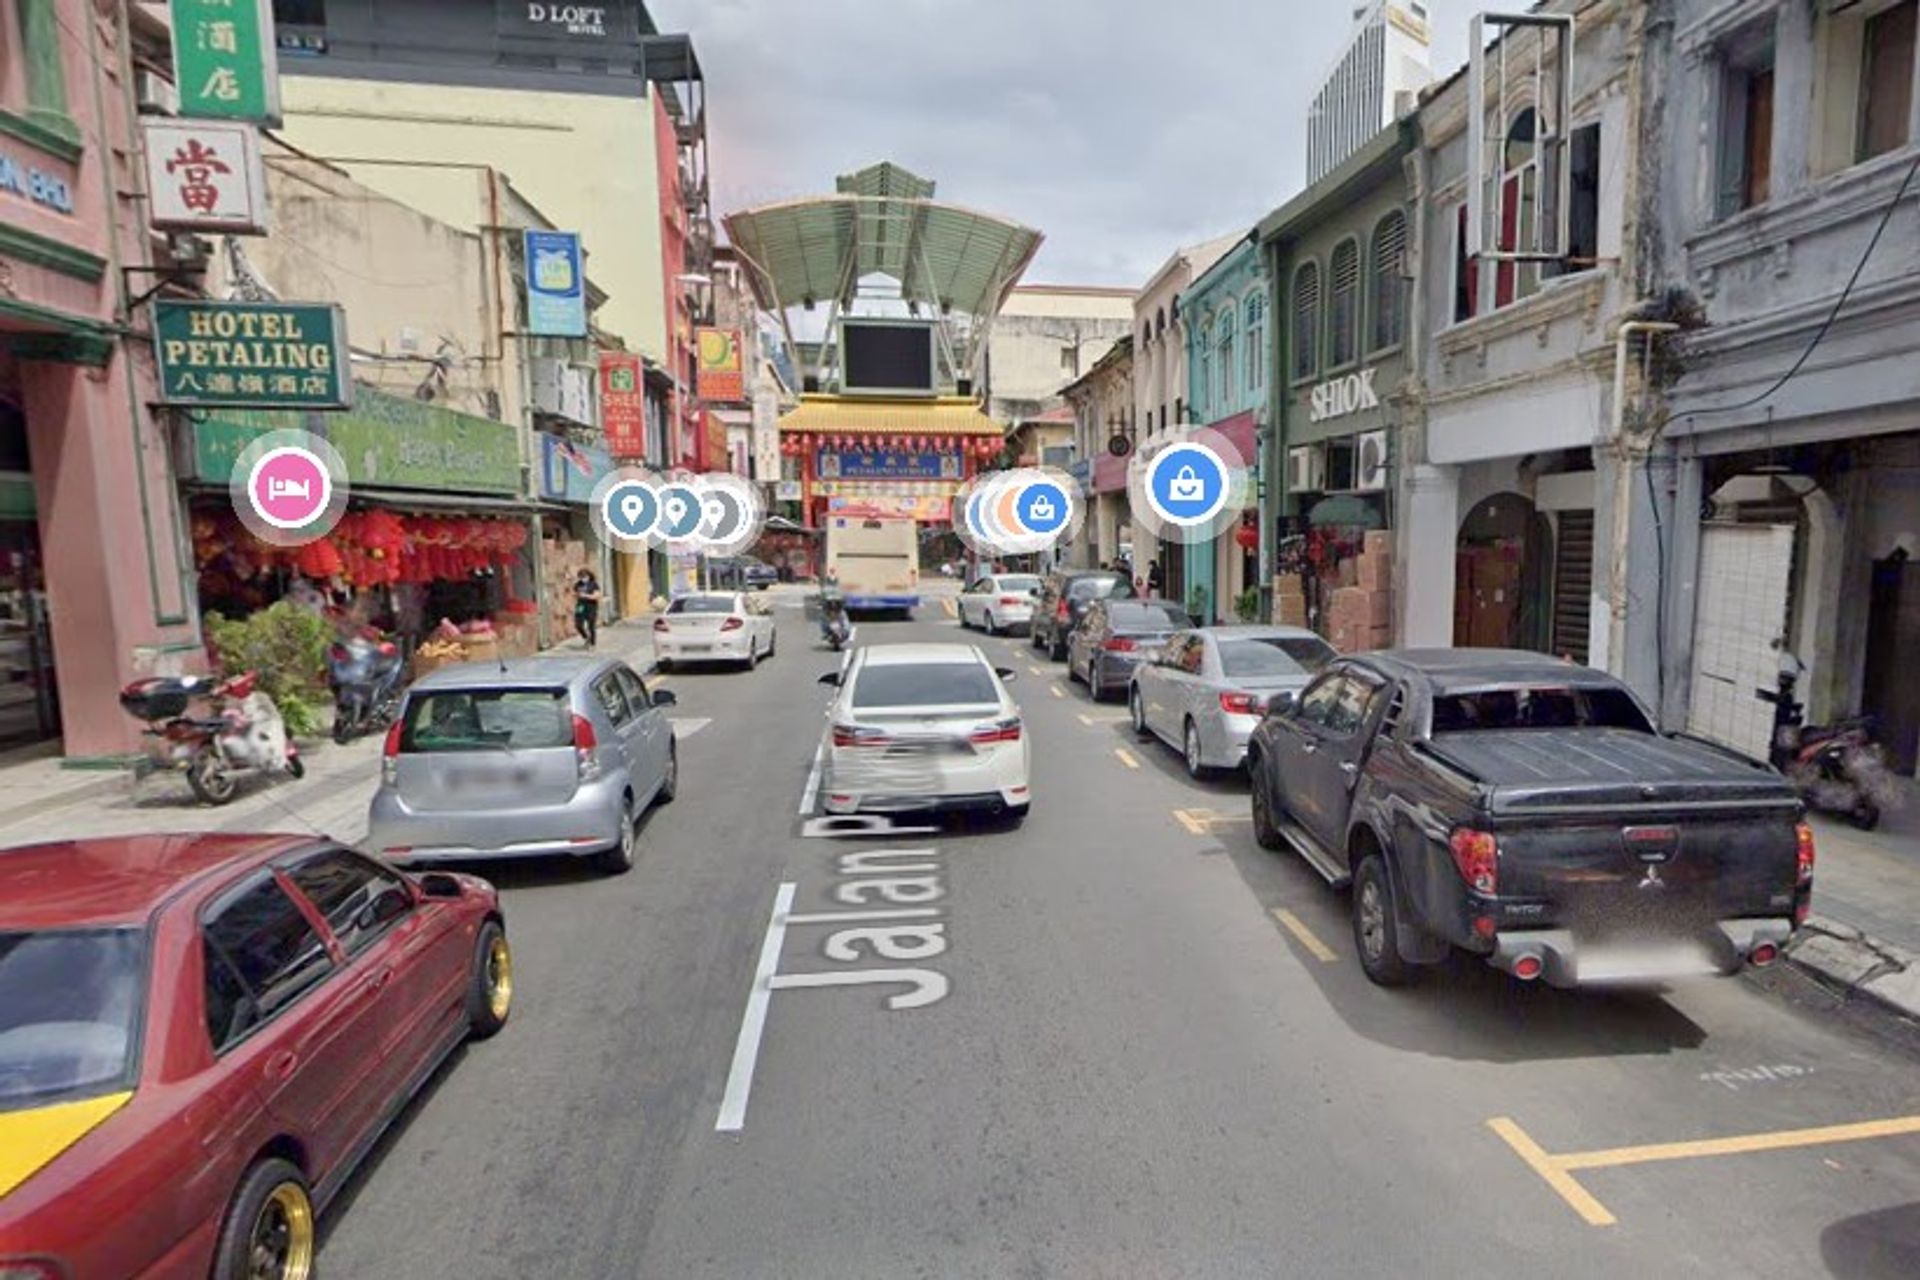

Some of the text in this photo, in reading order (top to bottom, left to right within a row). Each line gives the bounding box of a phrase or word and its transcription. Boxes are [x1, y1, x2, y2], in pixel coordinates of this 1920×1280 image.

[528, 3, 606, 24] D LOFT
[197, 0, 241, 101] 酒店
[166, 138, 232, 213] 當
[190, 311, 302, 338] HOTEL
[166, 340, 331, 370] PETALING
[1310, 368, 1379, 422] SHIOK
